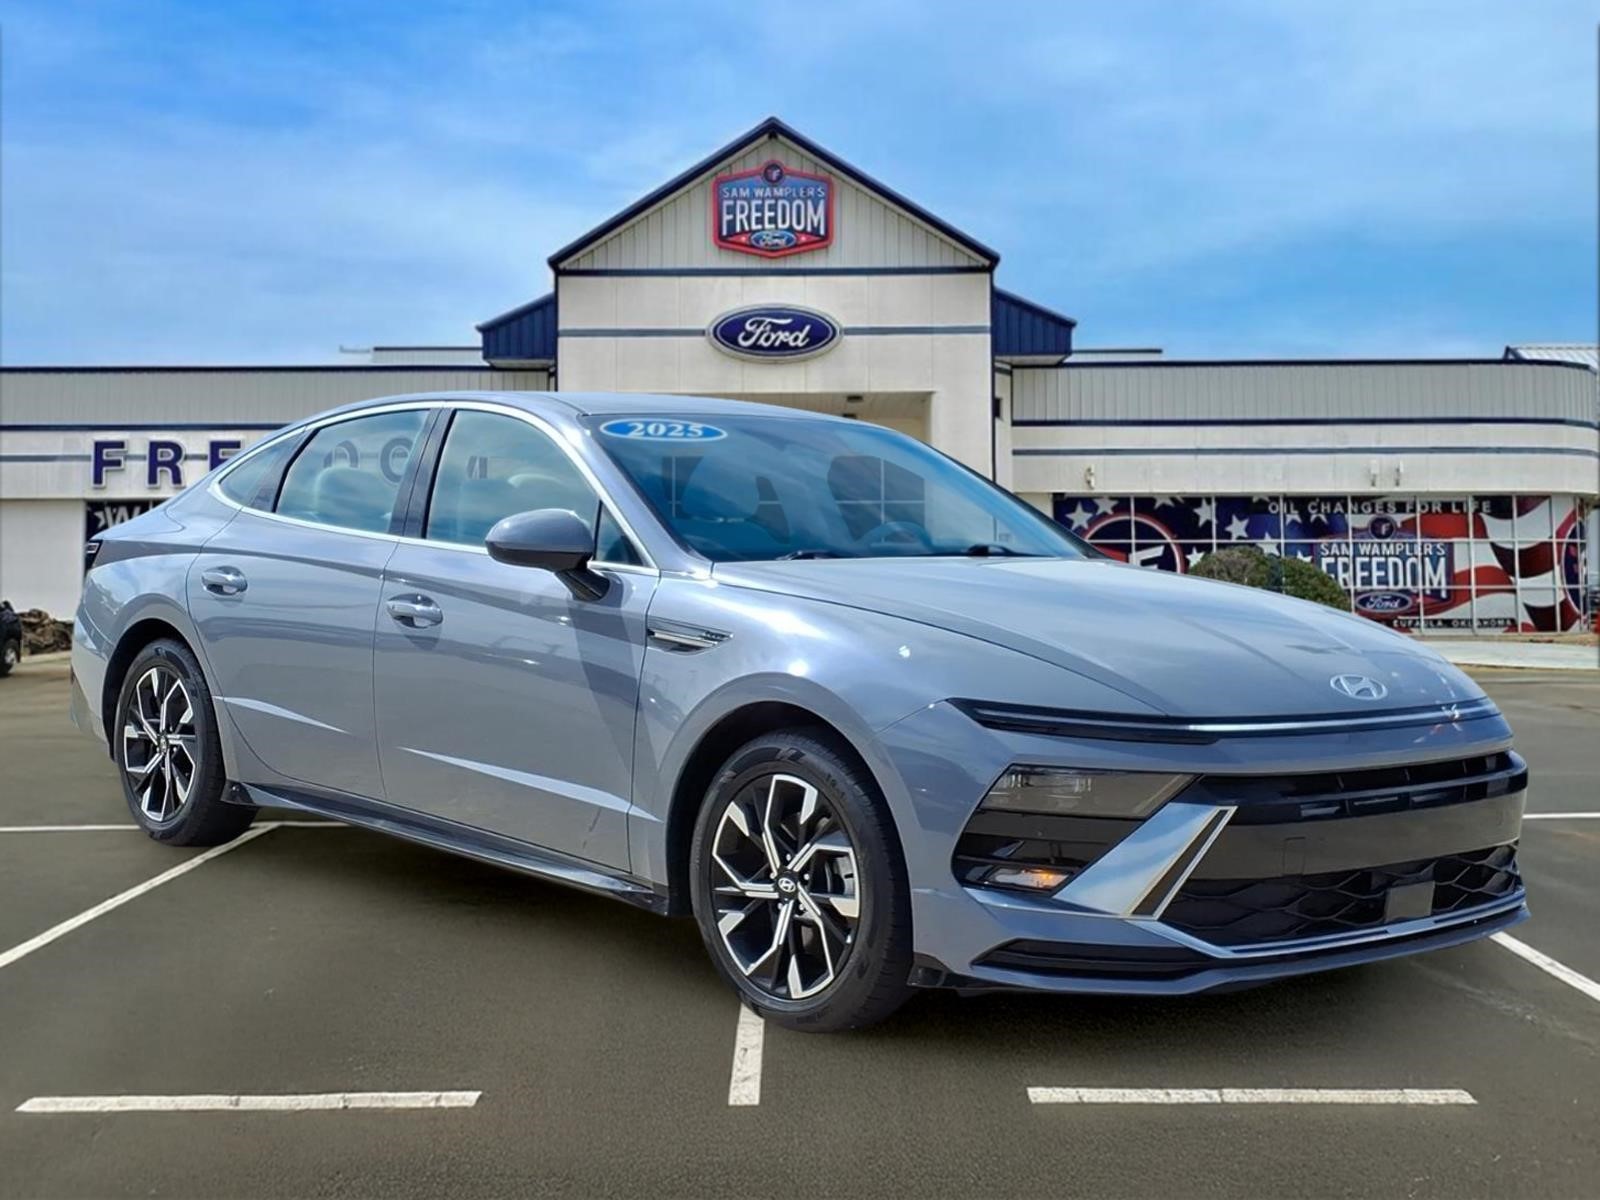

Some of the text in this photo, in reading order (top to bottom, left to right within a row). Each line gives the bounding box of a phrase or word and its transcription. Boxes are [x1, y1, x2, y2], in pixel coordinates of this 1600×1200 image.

[722, 187, 750, 198] SAM
[722, 199, 825, 236] FREEDOM
[737, 316, 811, 347] Ford
[627, 422, 703, 437] 2025
[1267, 501, 1491, 514] OIL CHANGES FOR LIFE
[1321, 557, 1447, 598] FREEDOM
[1366, 595, 1400, 609] Ford
